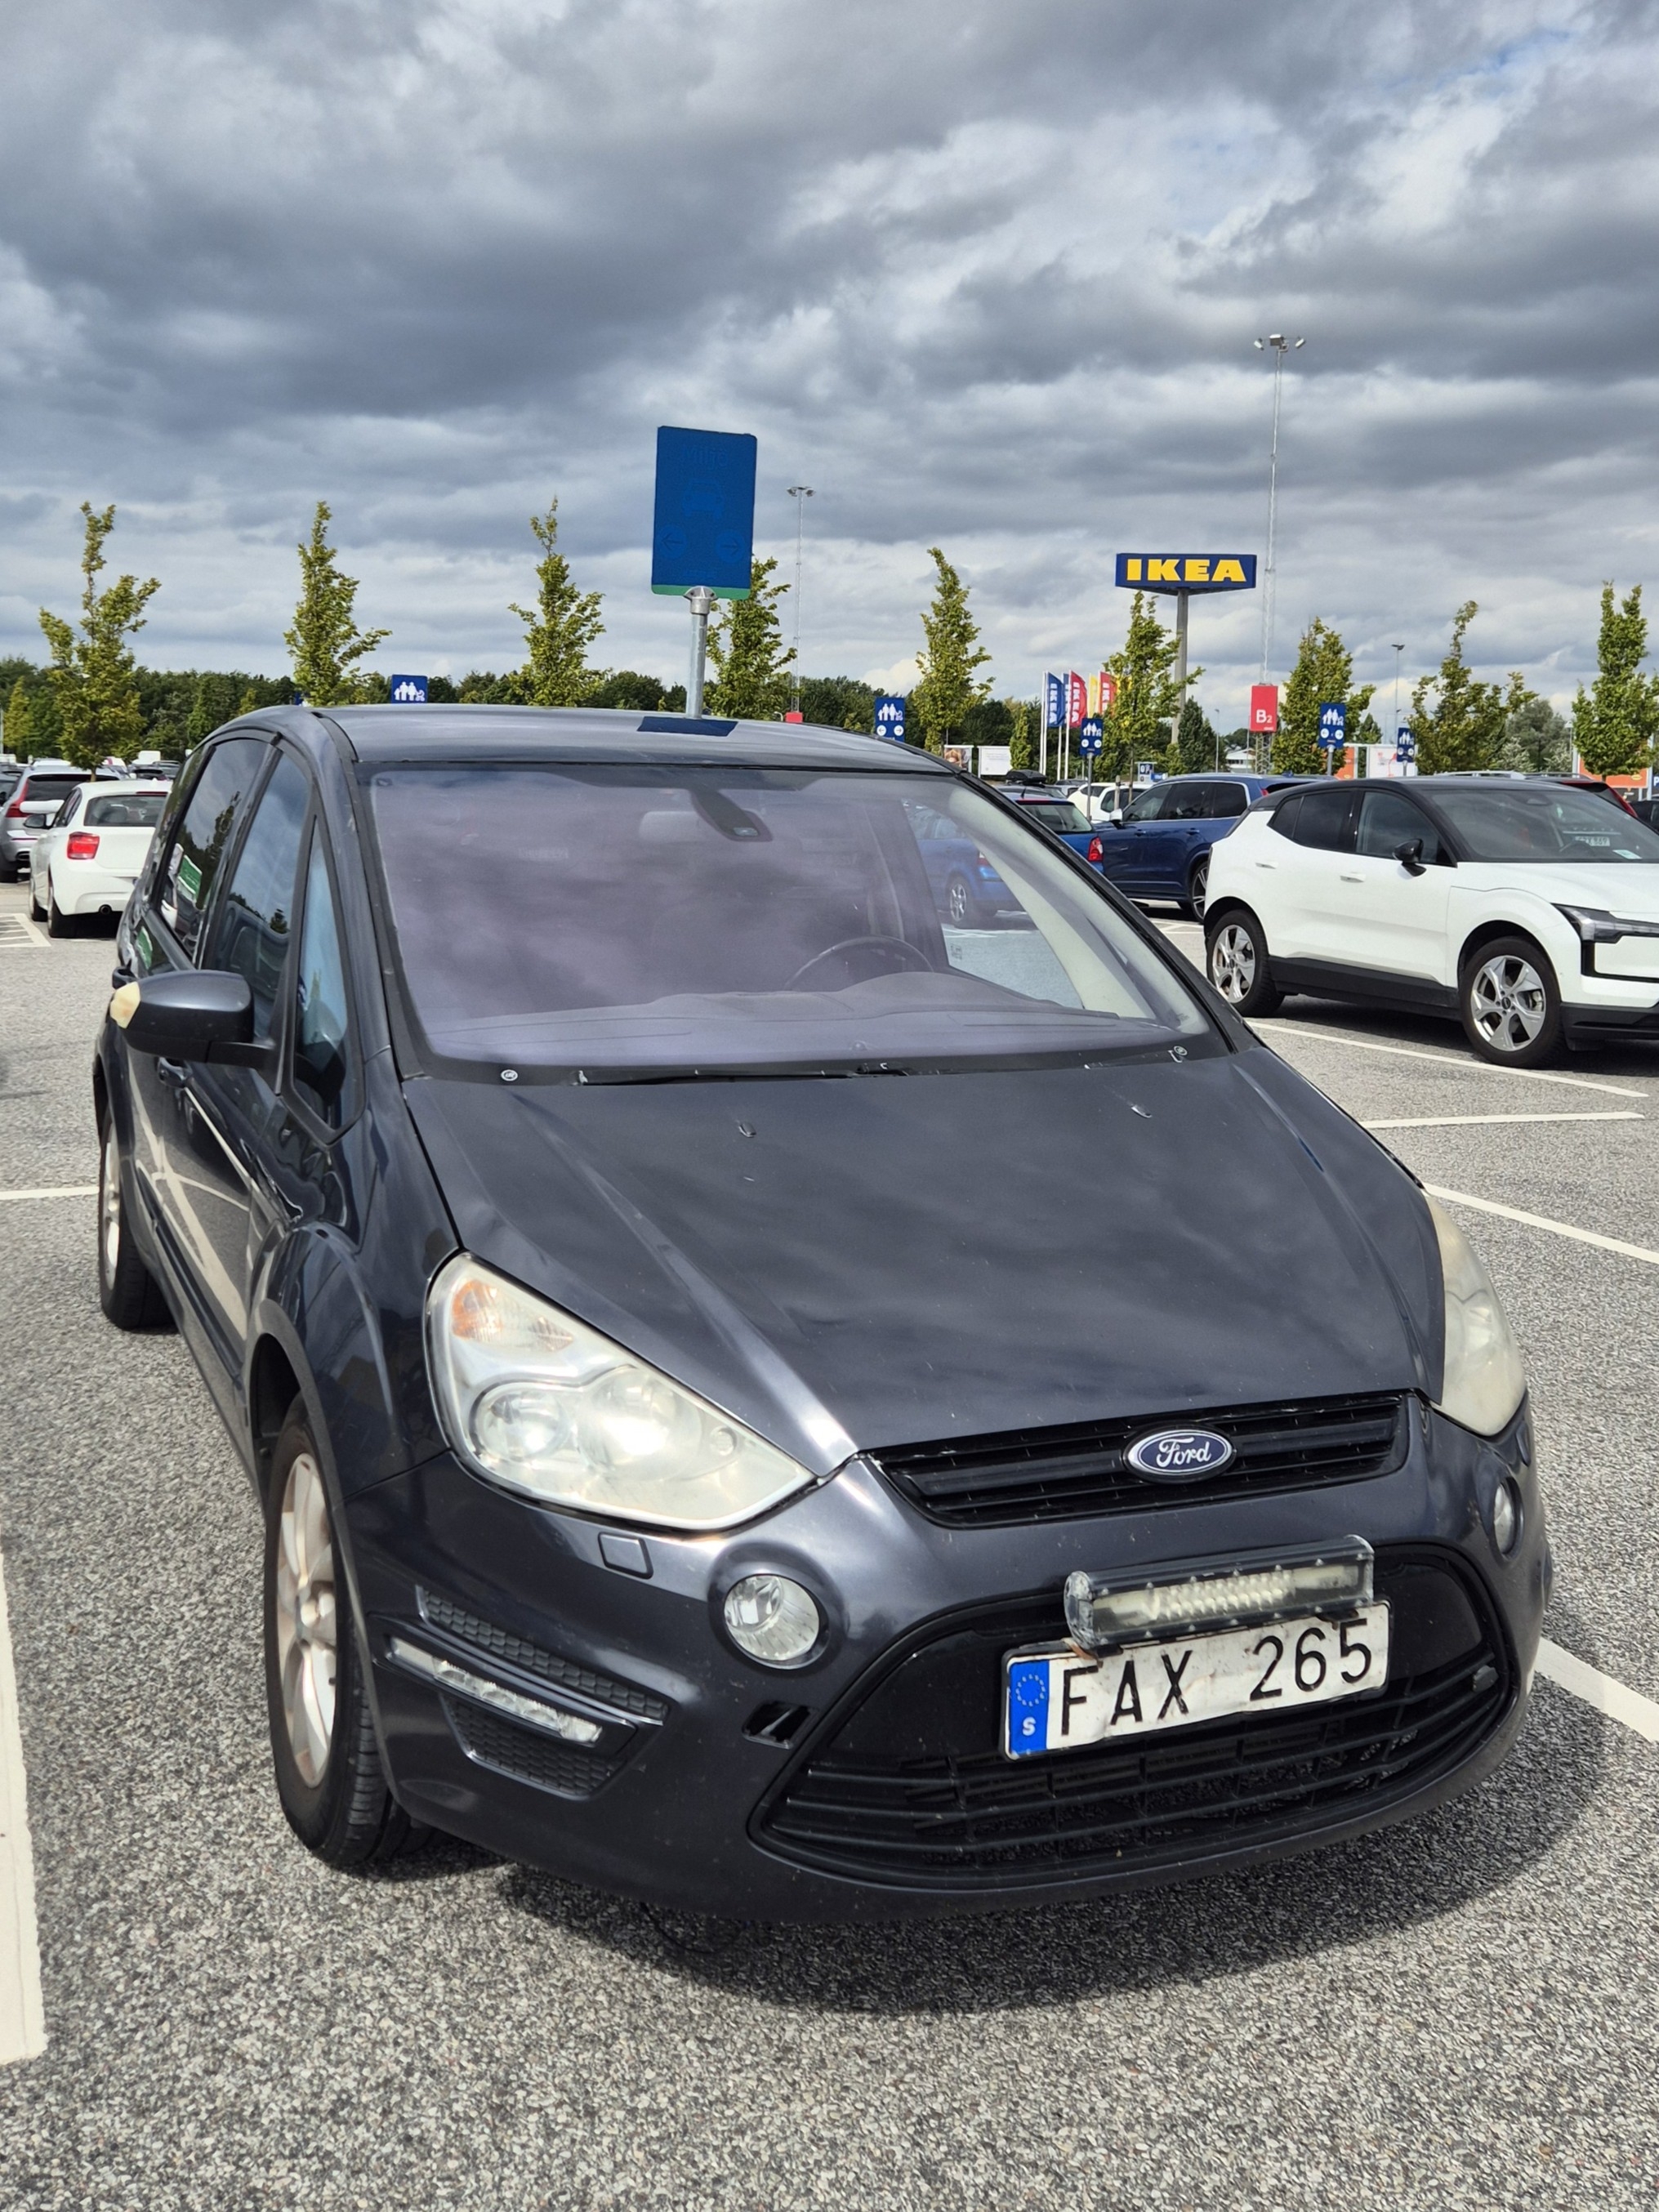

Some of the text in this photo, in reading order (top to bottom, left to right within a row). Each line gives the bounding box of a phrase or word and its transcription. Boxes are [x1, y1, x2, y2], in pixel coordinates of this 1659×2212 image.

[683, 445, 729, 472] Miljö
[1126, 559, 1246, 582] IKEA
[1049, 683, 1058, 725] IKEA
[1071, 681, 1080, 724] IKEA
[1255, 709, 1273, 724] B2
[1156, 1437, 1212, 1468] Ford
[1061, 1618, 1371, 1737] FAX 265
[1022, 1716, 1037, 1736] S
